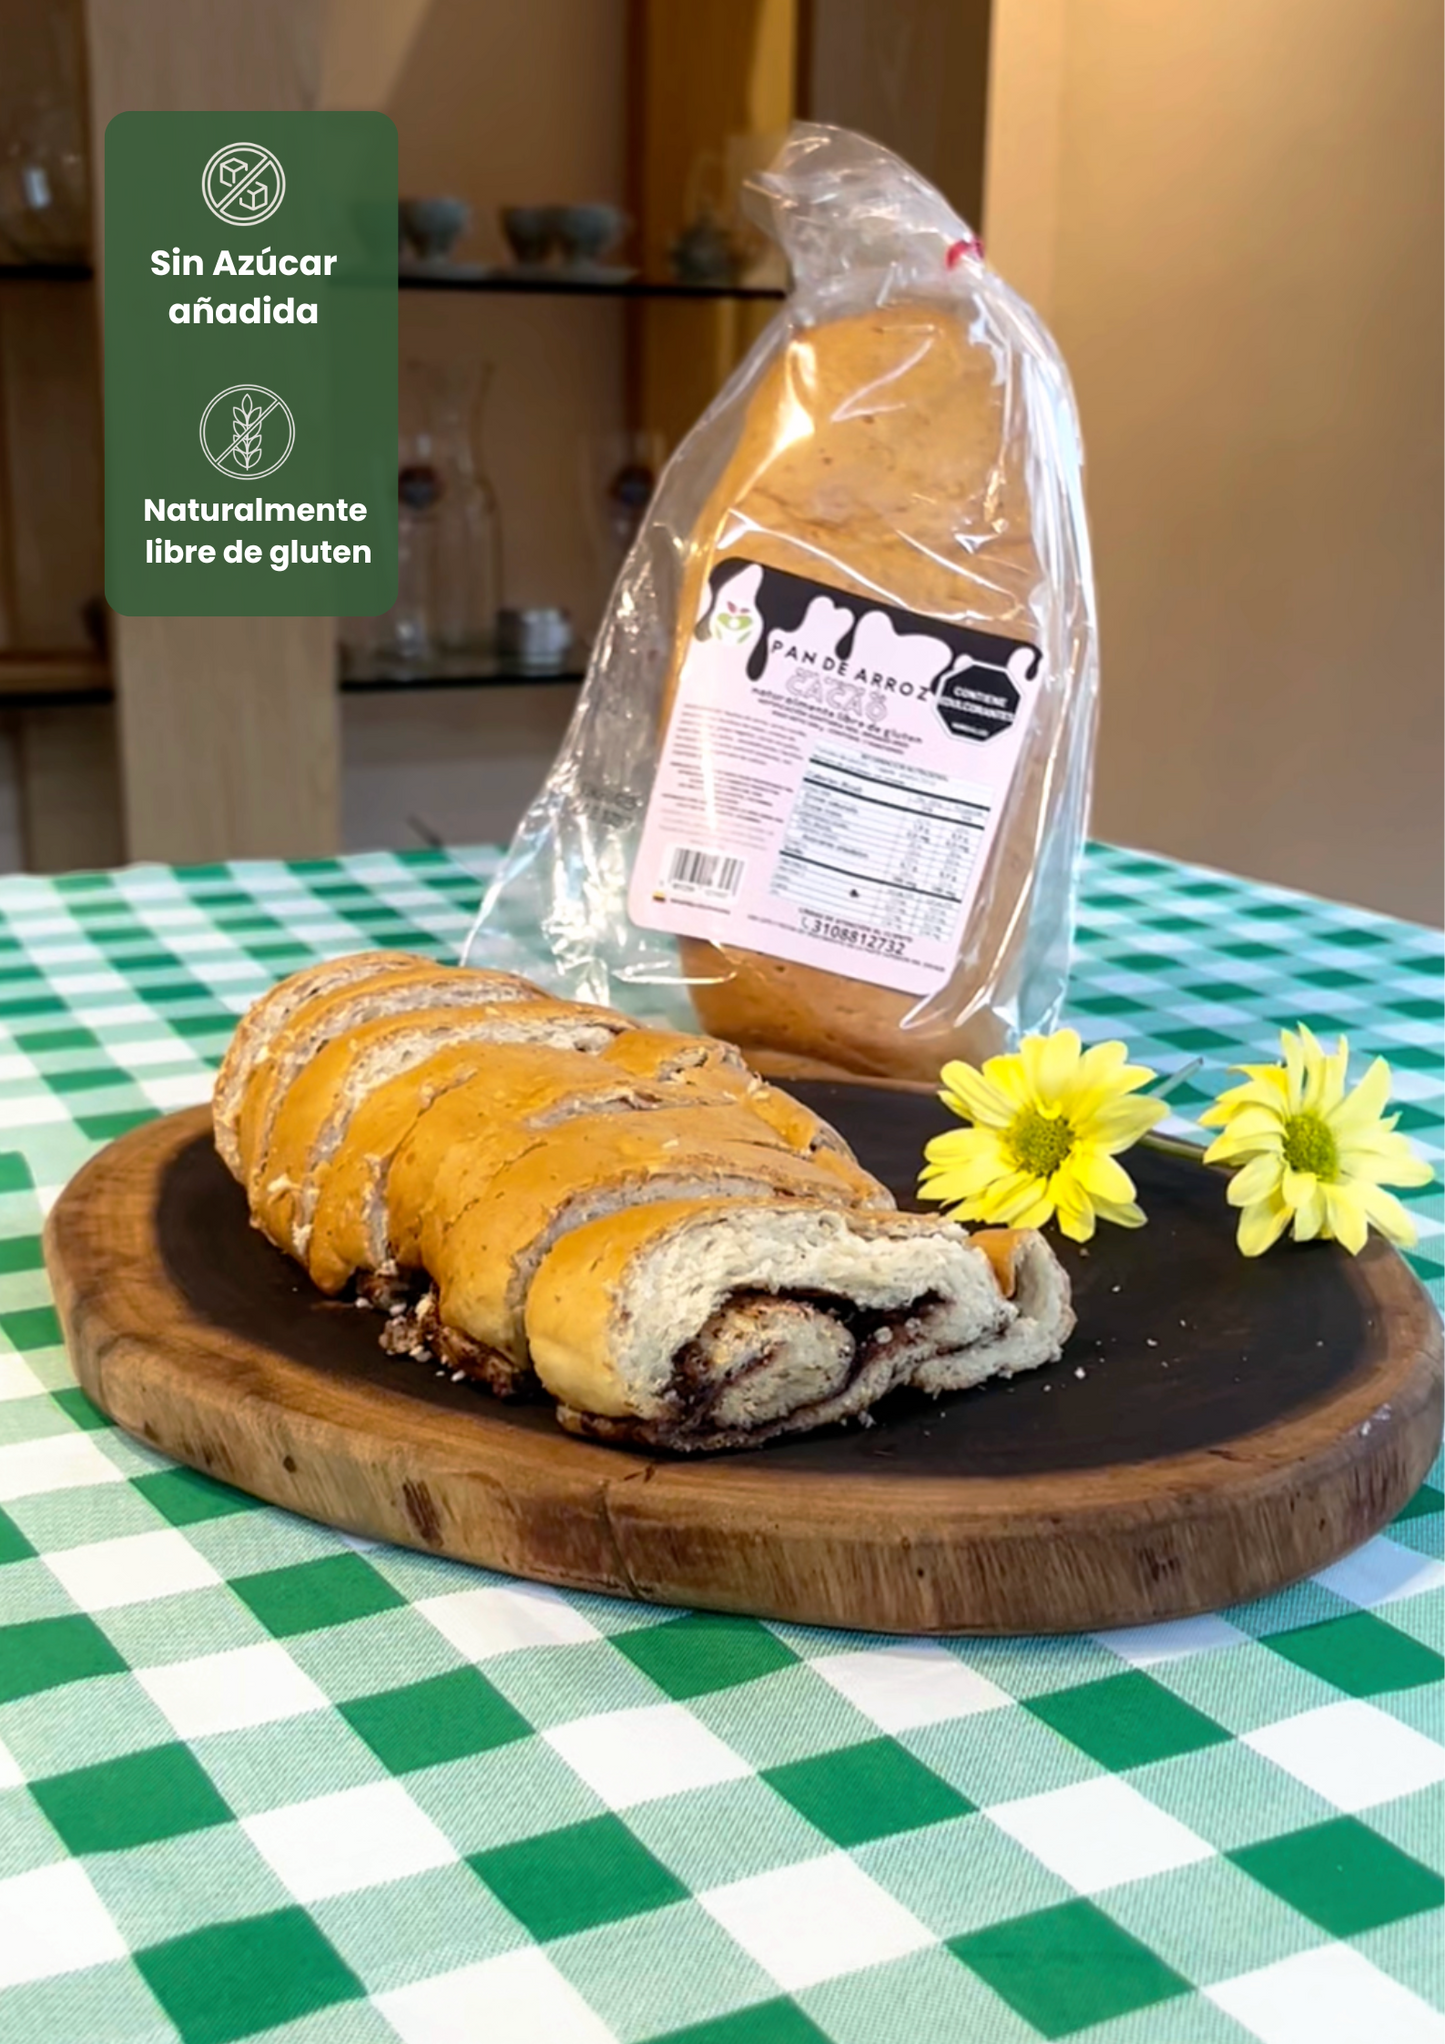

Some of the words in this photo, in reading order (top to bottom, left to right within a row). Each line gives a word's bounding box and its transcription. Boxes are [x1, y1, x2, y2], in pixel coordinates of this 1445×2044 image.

[771, 640, 817, 665] PAN
[822, 657, 849, 677] DE
[854, 668, 931, 702] ARROZ
